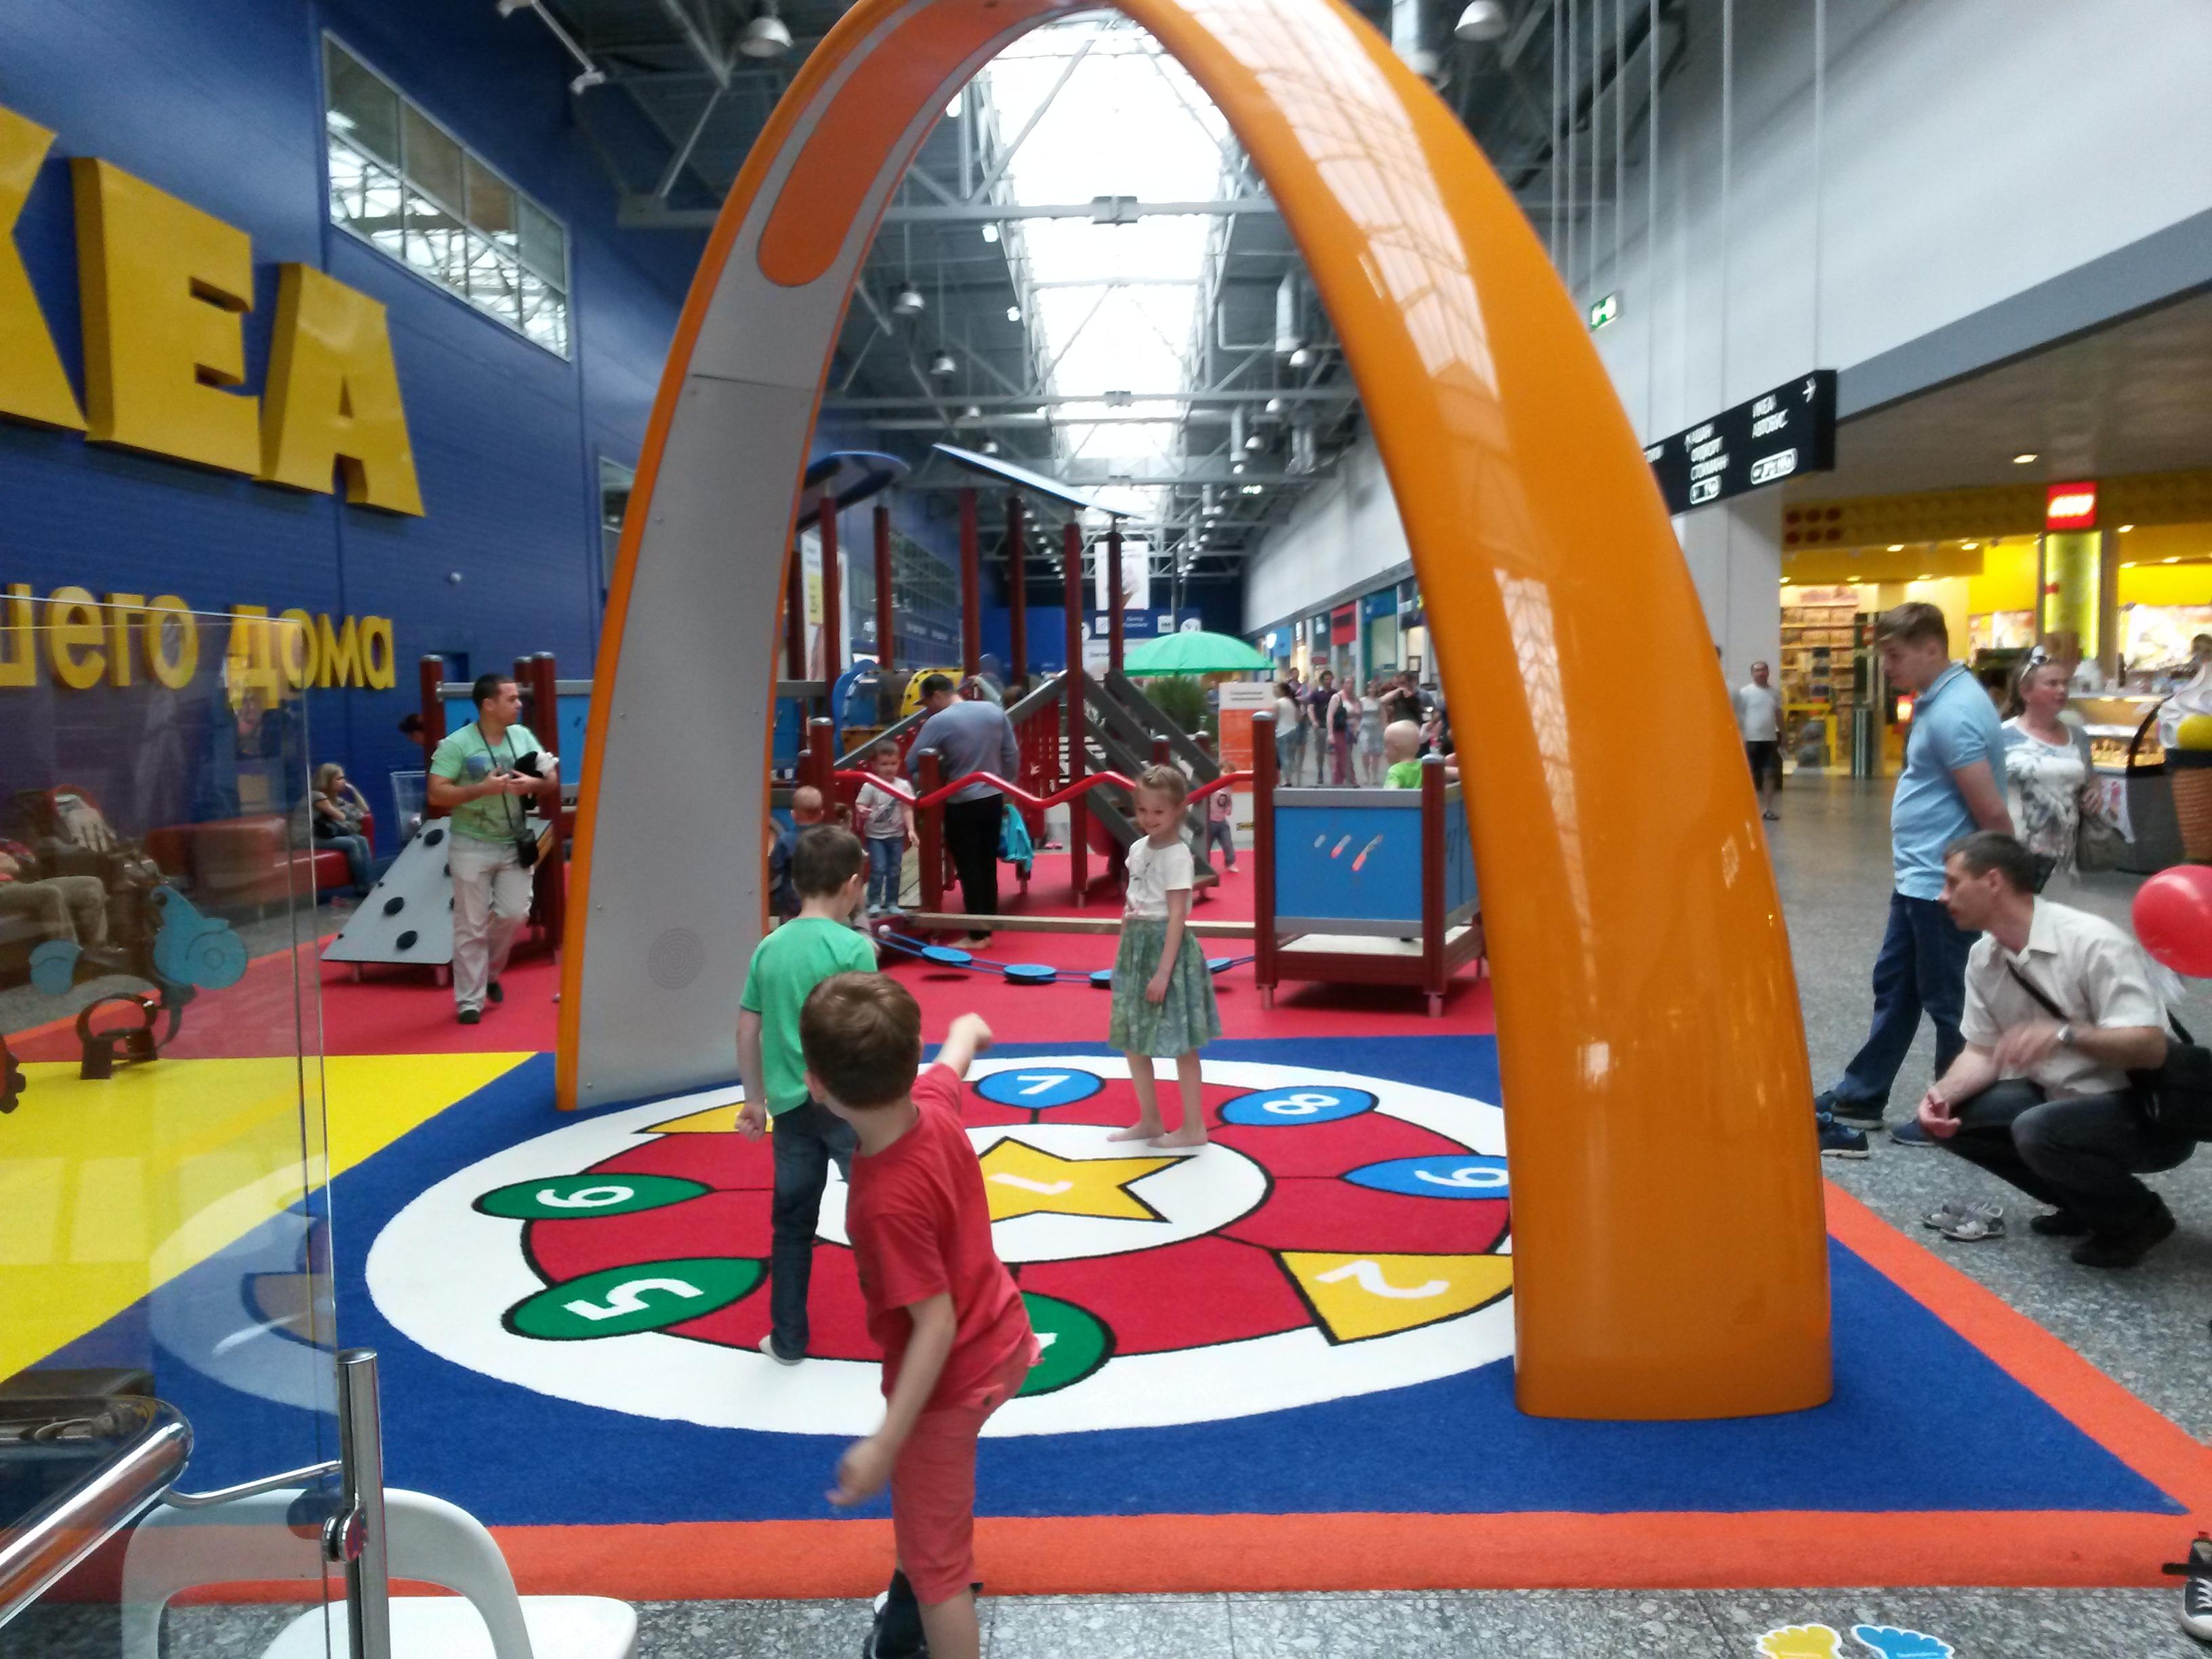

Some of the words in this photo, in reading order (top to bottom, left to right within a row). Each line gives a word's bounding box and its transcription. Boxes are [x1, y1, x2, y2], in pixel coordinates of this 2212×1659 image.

[1263, 1093, 1339, 1115] 8
[562, 1277, 704, 1321] 5
[1315, 1259, 1450, 1299] 2
